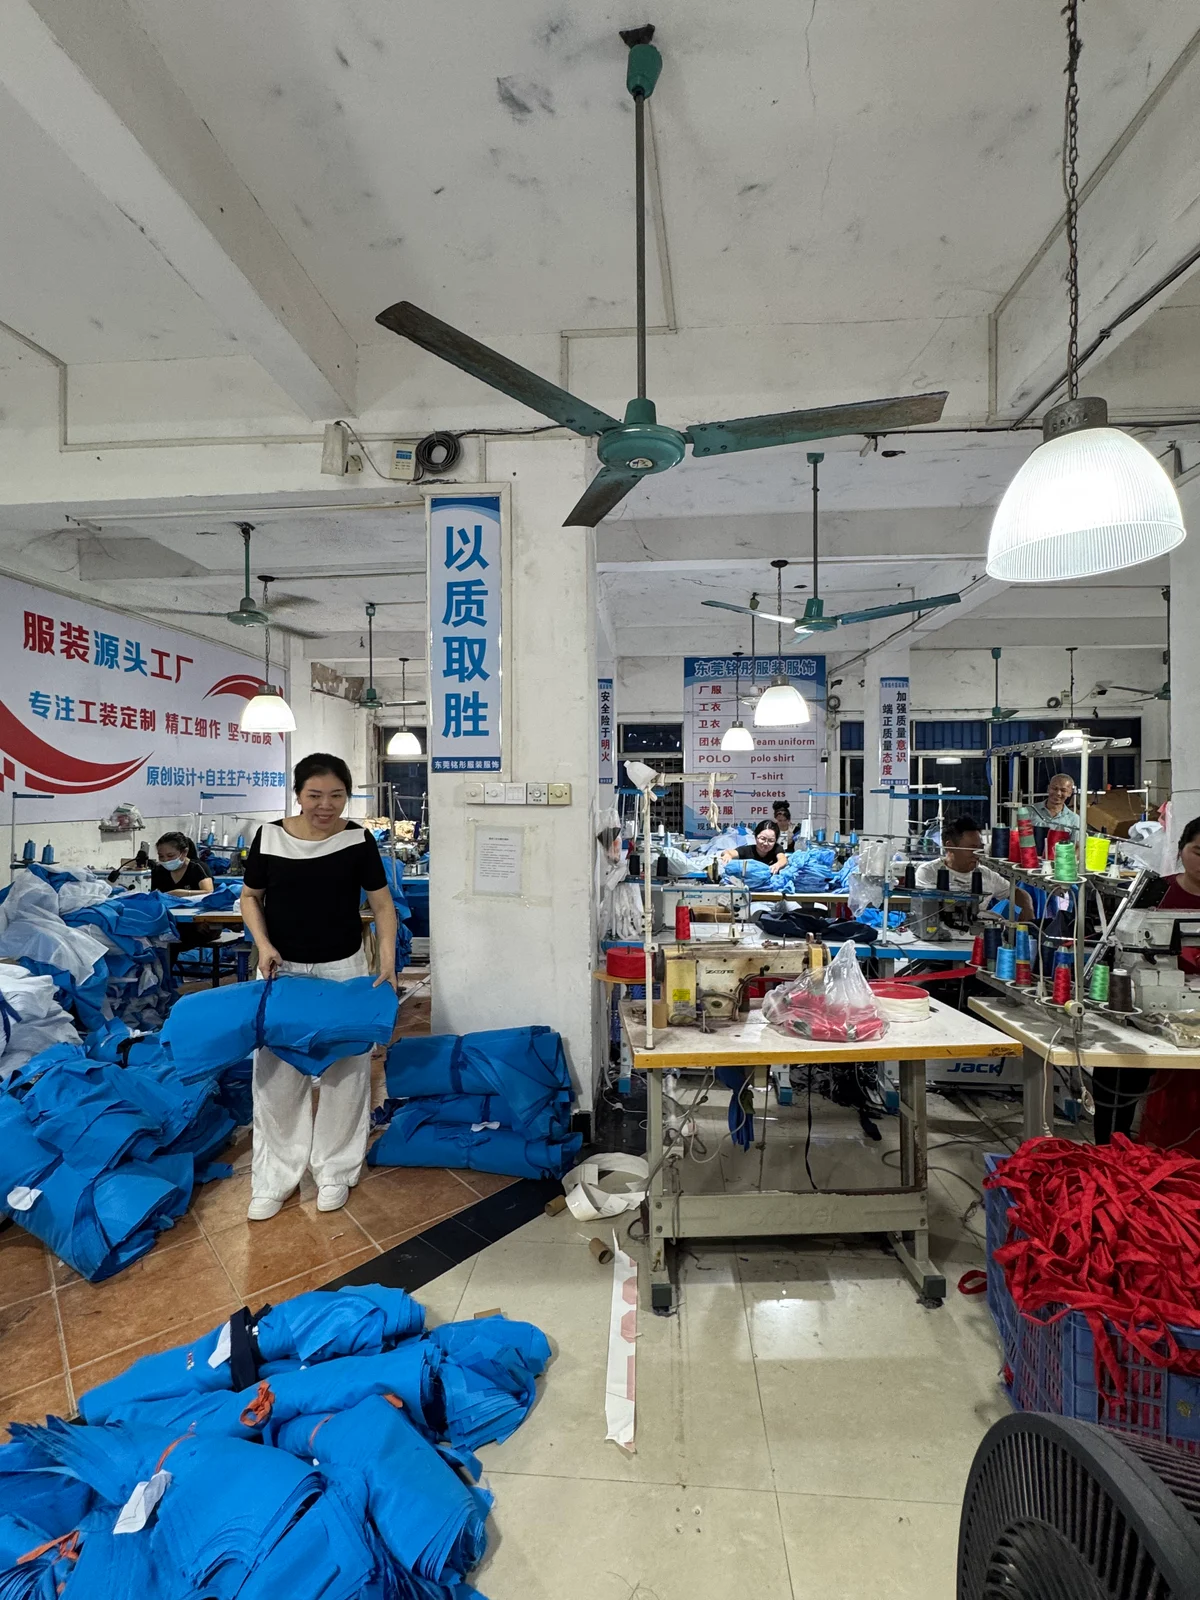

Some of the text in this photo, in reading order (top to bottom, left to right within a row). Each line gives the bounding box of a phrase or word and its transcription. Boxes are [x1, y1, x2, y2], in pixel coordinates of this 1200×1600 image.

[442, 525, 490, 738] 以质取胜
[23, 610, 194, 684] 服装源头工厂
[698, 685, 722, 695] 厂服
[699, 702, 721, 712] 工衣
[28, 690, 156, 732] 专注工装定制
[165, 711, 221, 740] 精工细作
[698, 719, 720, 728] 卫衣
[896, 690, 907, 763] 加强质量意识
[778, 737, 815, 746] uniform
[882, 703, 893, 776] 端正质量态度
[699, 755, 731, 763] POLO
[750, 753, 795, 764] polo shirt
[146, 765, 286, 788] 原创设计+自主生产+支持定制
[751, 772, 784, 780] T-shirt
[751, 789, 786, 798] Jackets
[699, 805, 733, 815] 劳服
